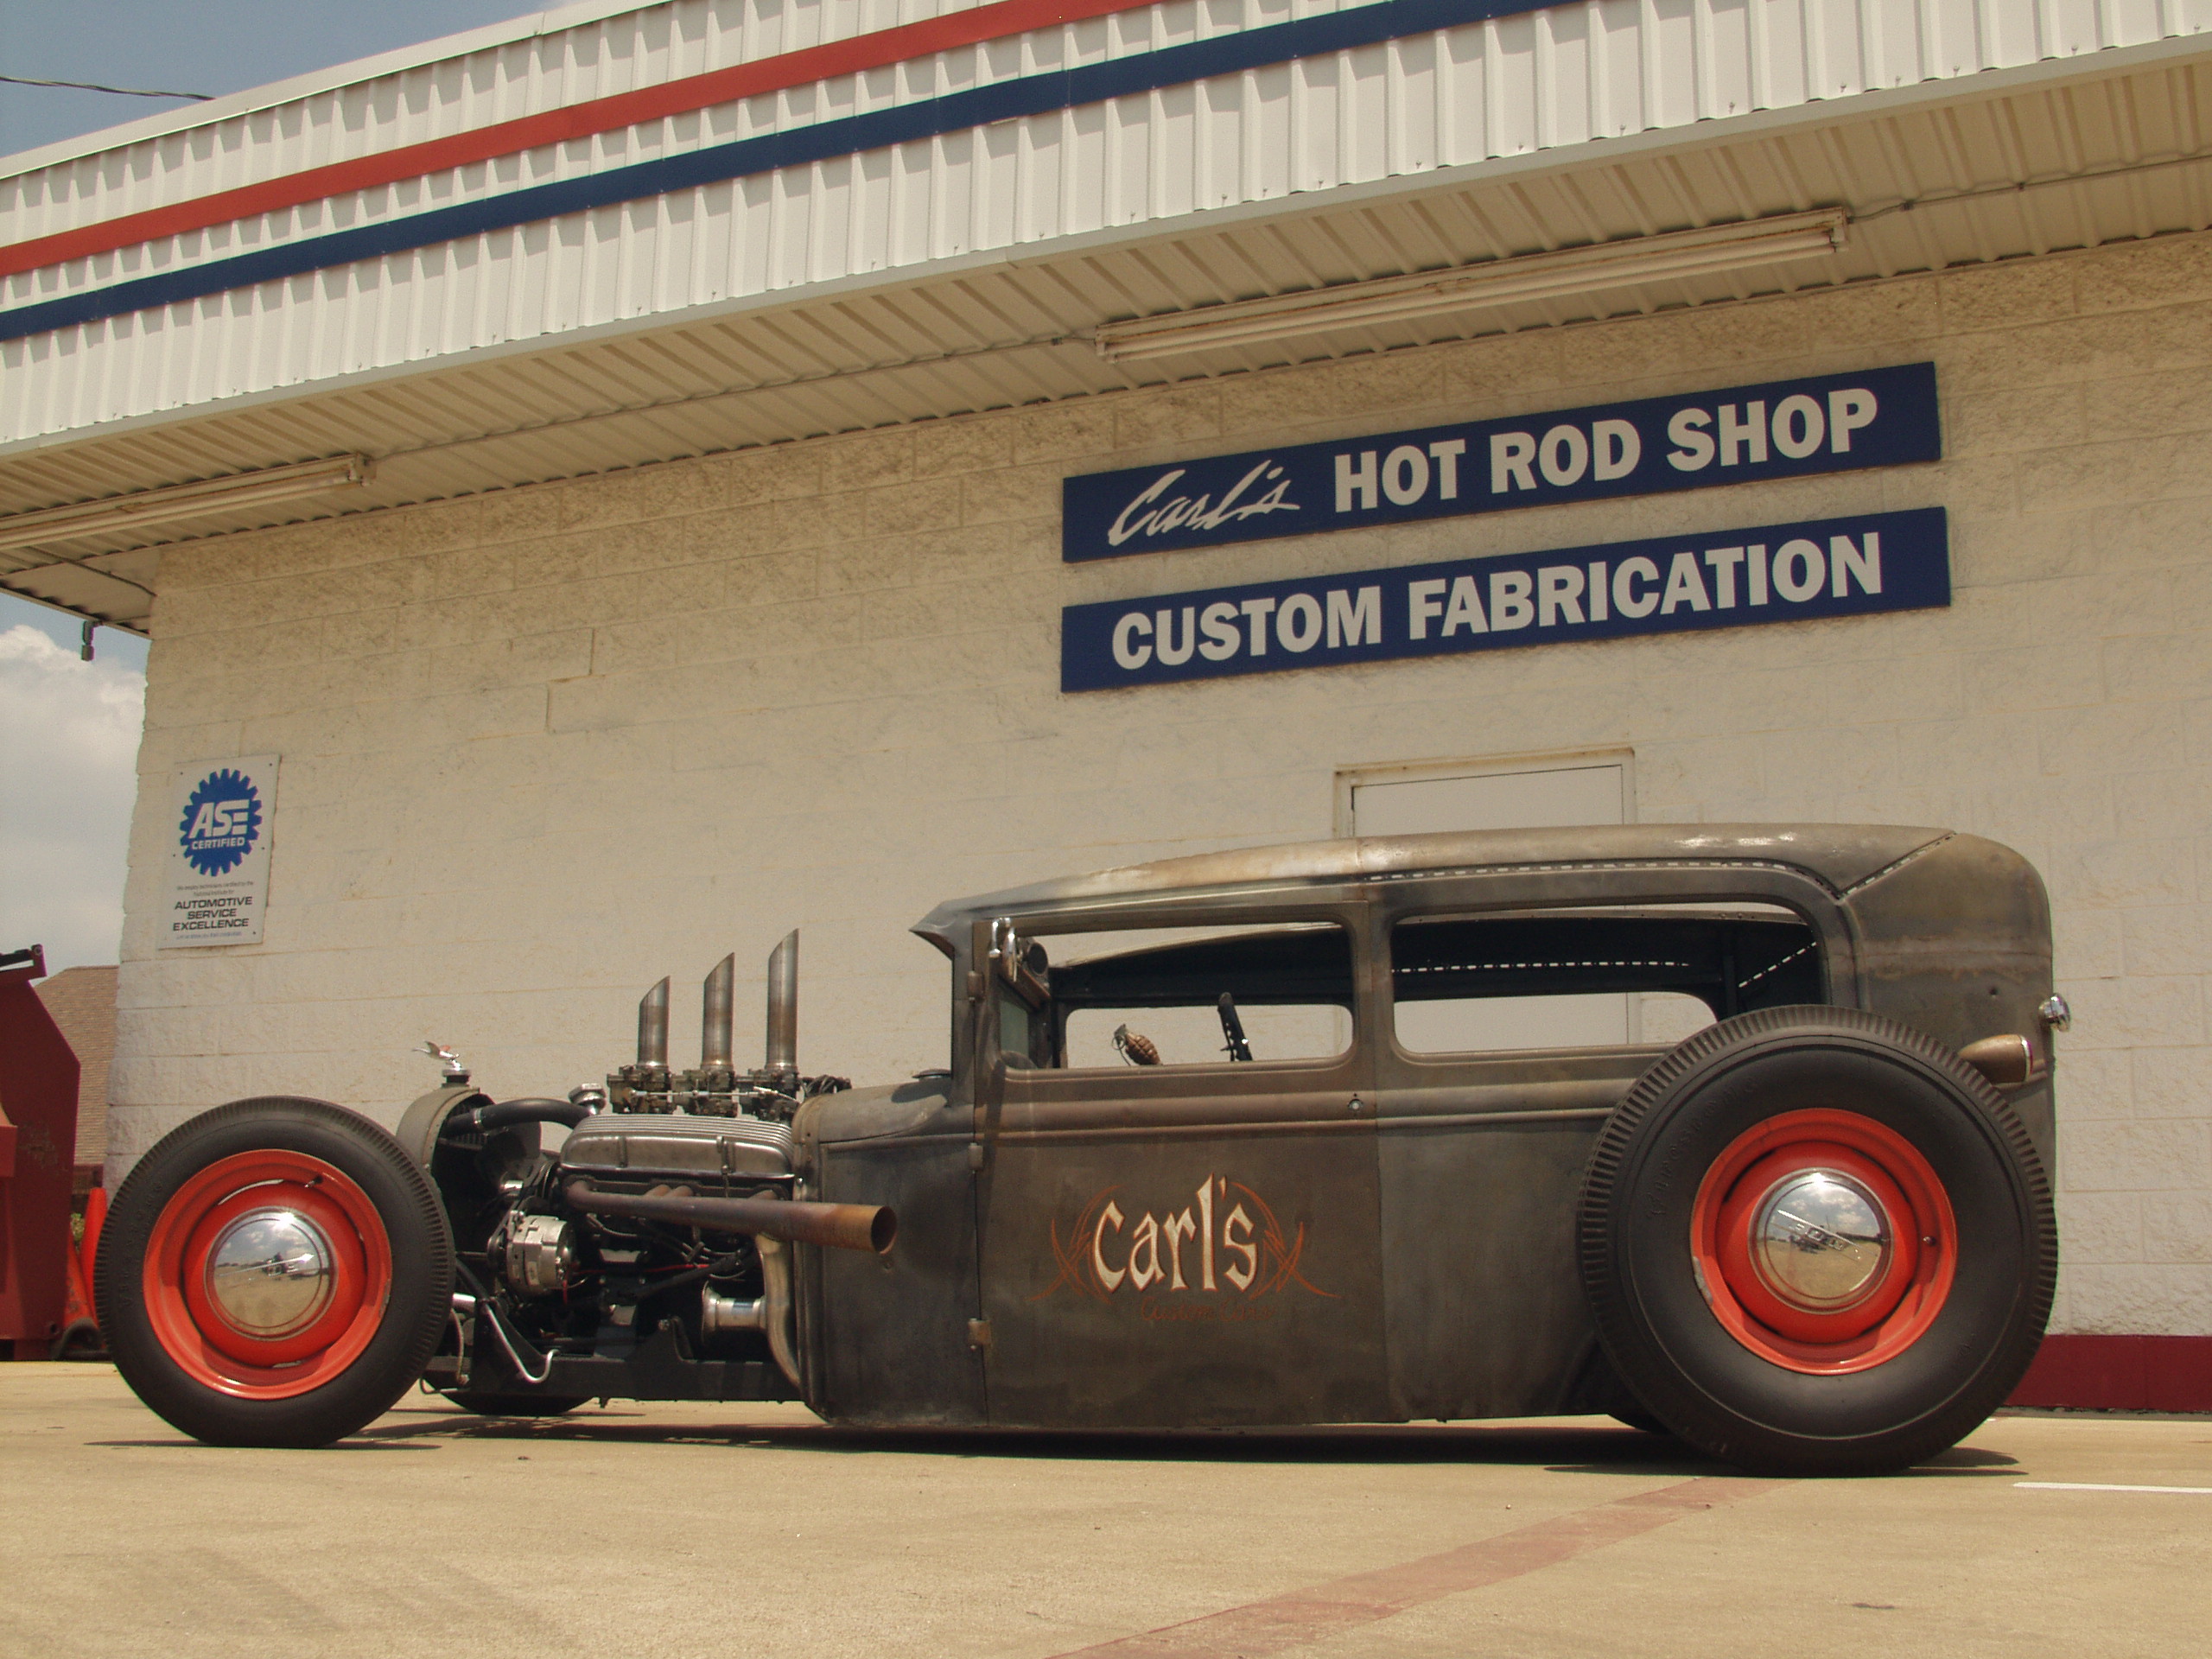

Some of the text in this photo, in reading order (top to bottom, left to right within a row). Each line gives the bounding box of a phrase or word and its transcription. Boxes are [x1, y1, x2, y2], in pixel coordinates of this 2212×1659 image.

[1108, 388, 1878, 546] Carl's HOT ROD SHOP
[1112, 531, 1882, 670] CUSTOM FABRICATION
[189, 799, 250, 839] ASE
[192, 837, 245, 850] CERTIFIED
[175, 896, 252, 910] AUTOMOTIVE
[188, 908, 237, 920] SERVICE
[173, 918, 249, 931] EXCELLENCE
